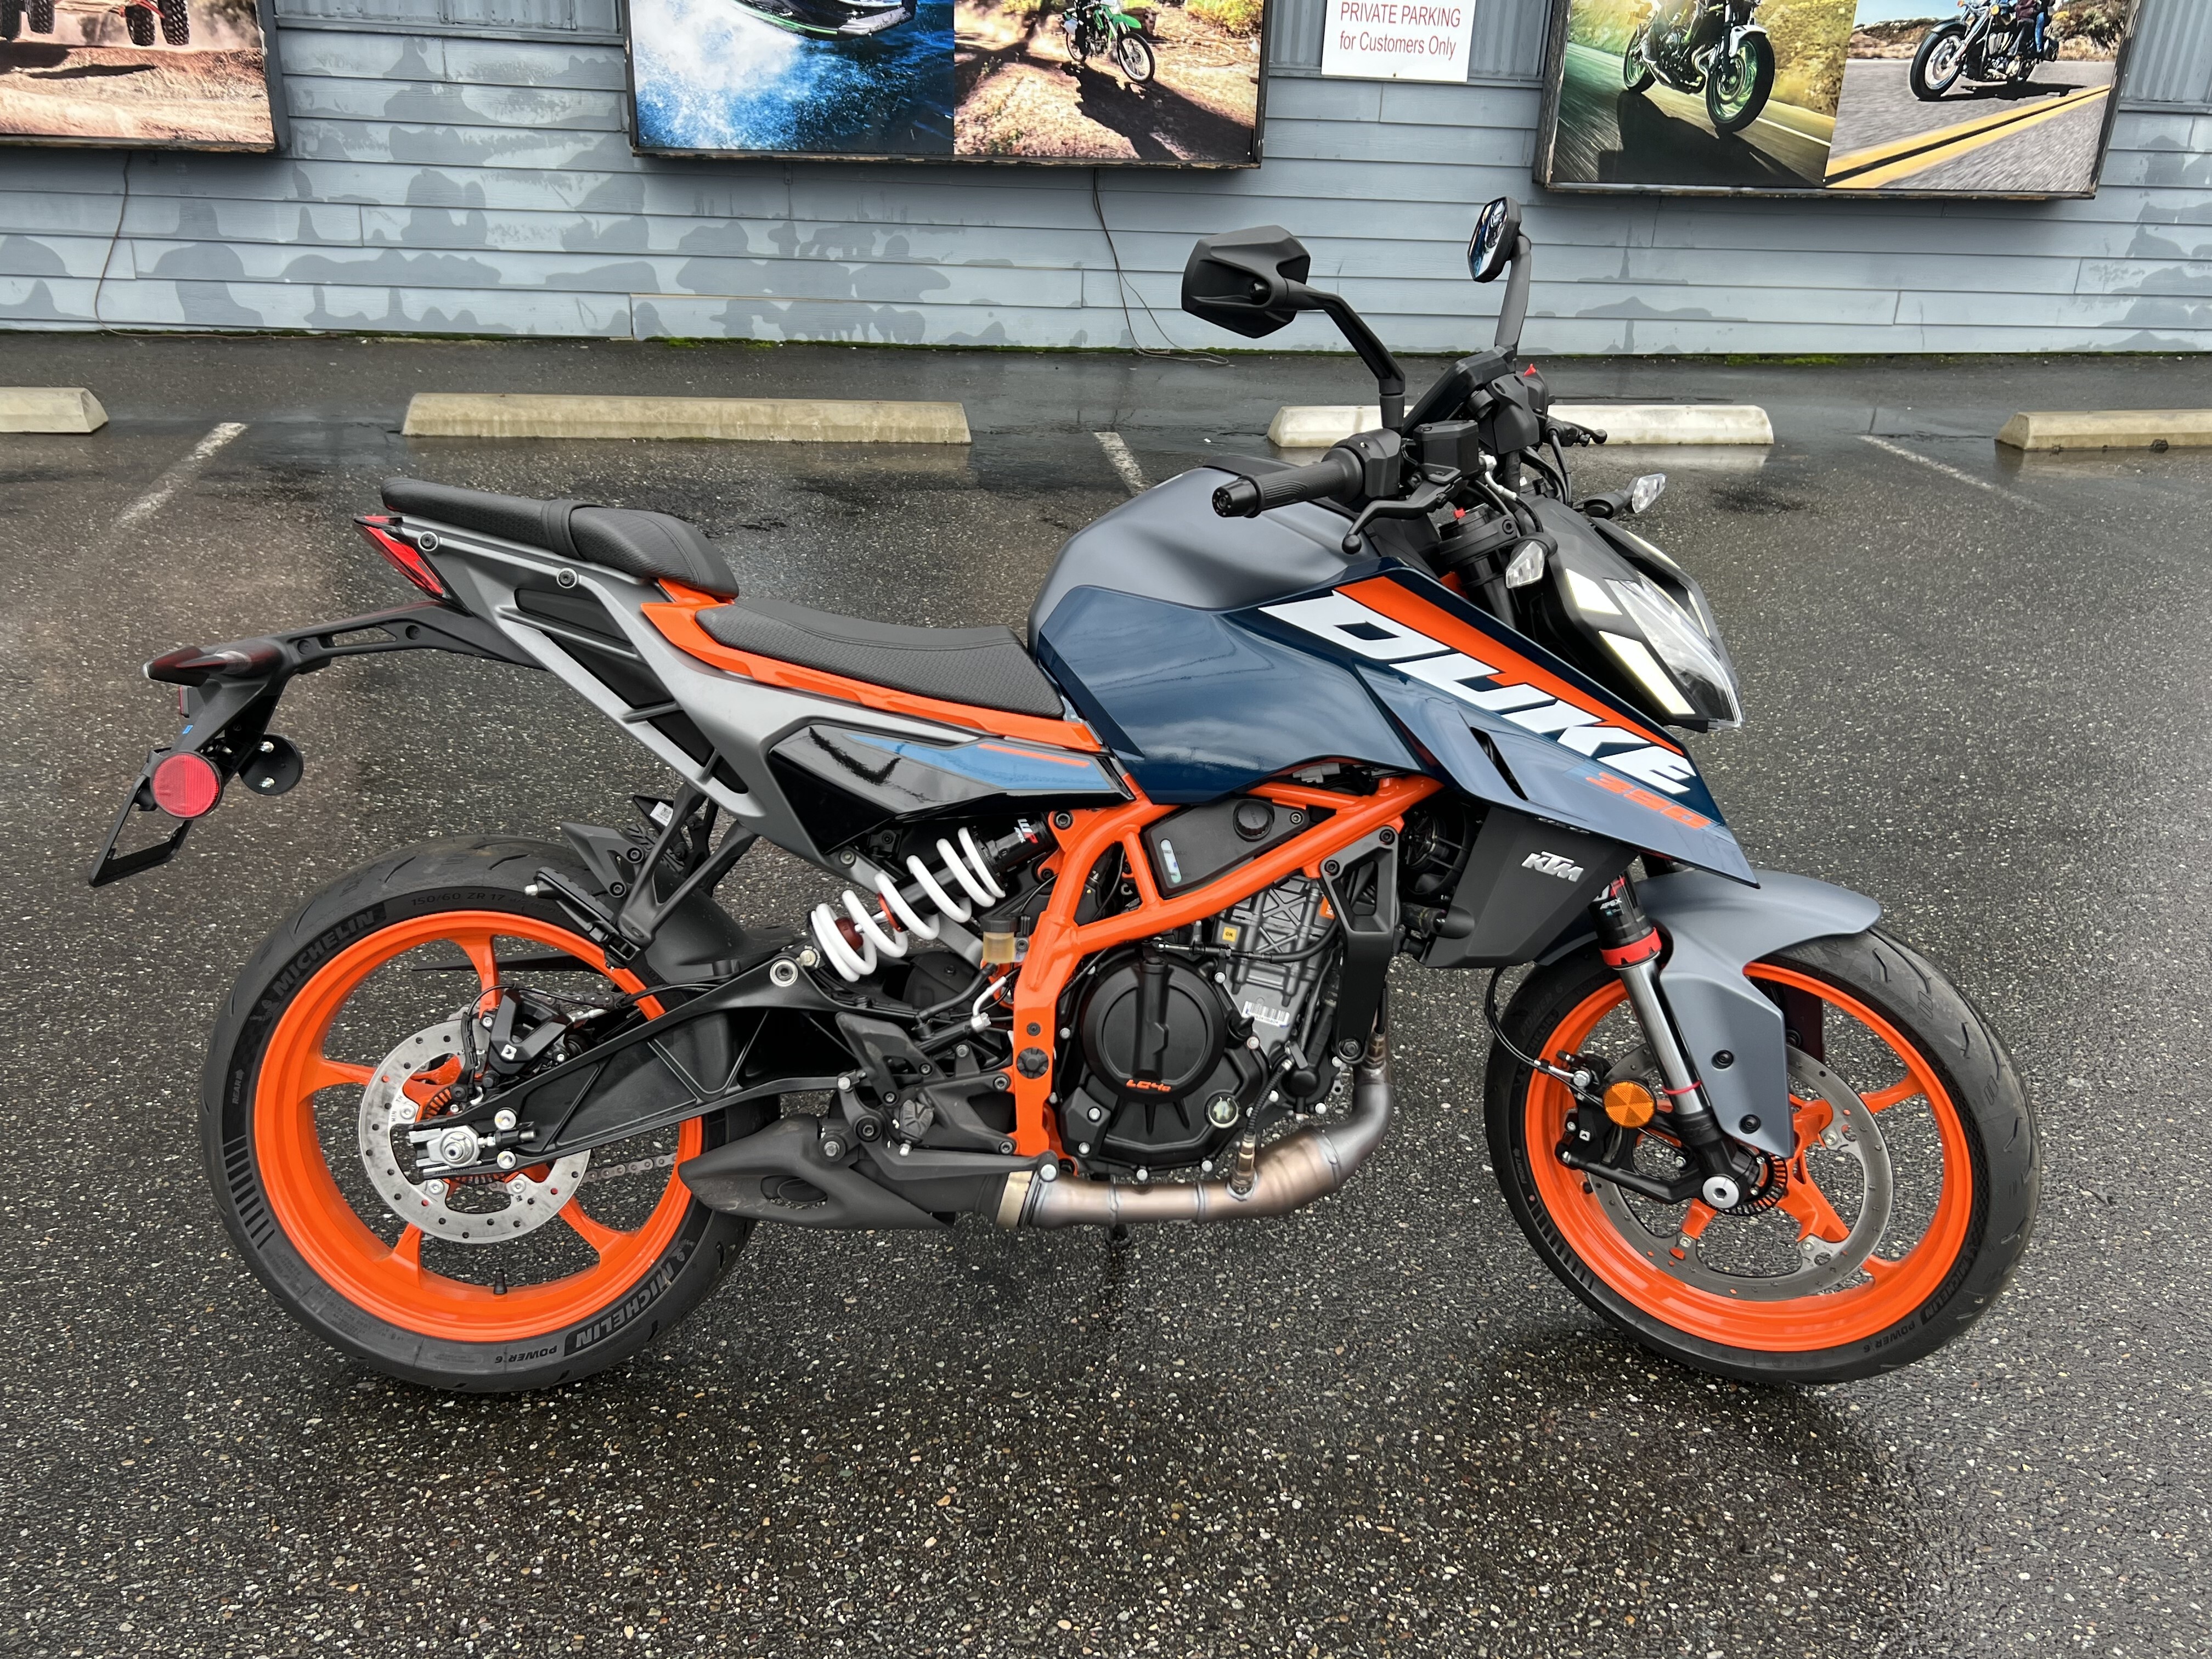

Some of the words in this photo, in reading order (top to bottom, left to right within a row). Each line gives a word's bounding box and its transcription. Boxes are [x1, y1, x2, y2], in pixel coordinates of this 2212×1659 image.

[1340, 2, 1398, 24] PRIVATE
[1401, 5, 1460, 27] PARKING
[1340, 31, 1356, 50] for
[1359, 31, 1424, 54] Customers
[1429, 35, 1456, 61] Only
[1257, 589, 1697, 794] DUKE
[1585, 771, 1712, 830] 390
[1014, 826, 1026, 844] APEX
[1017, 818, 1039, 844] WP
[1521, 850, 1584, 883] KTM
[410, 891, 461, 906] 150/60
[466, 891, 486, 900] ZR
[490, 893, 506, 901] 17
[1600, 897, 1623, 910] APEX
[272, 910, 375, 997] MICHELIN
[232, 1079, 242, 1104] REAR
[1515, 1157, 1528, 1184] FRONT
[1924, 1256, 1970, 1318] MICHELIN
[575, 1262, 675, 1348] MICHELIN
[1875, 1319, 1916, 1348] POWER
[494, 1355, 504, 1364] 6
[508, 1345, 558, 1363] POWER
[1863, 1344, 1871, 1353] 6
